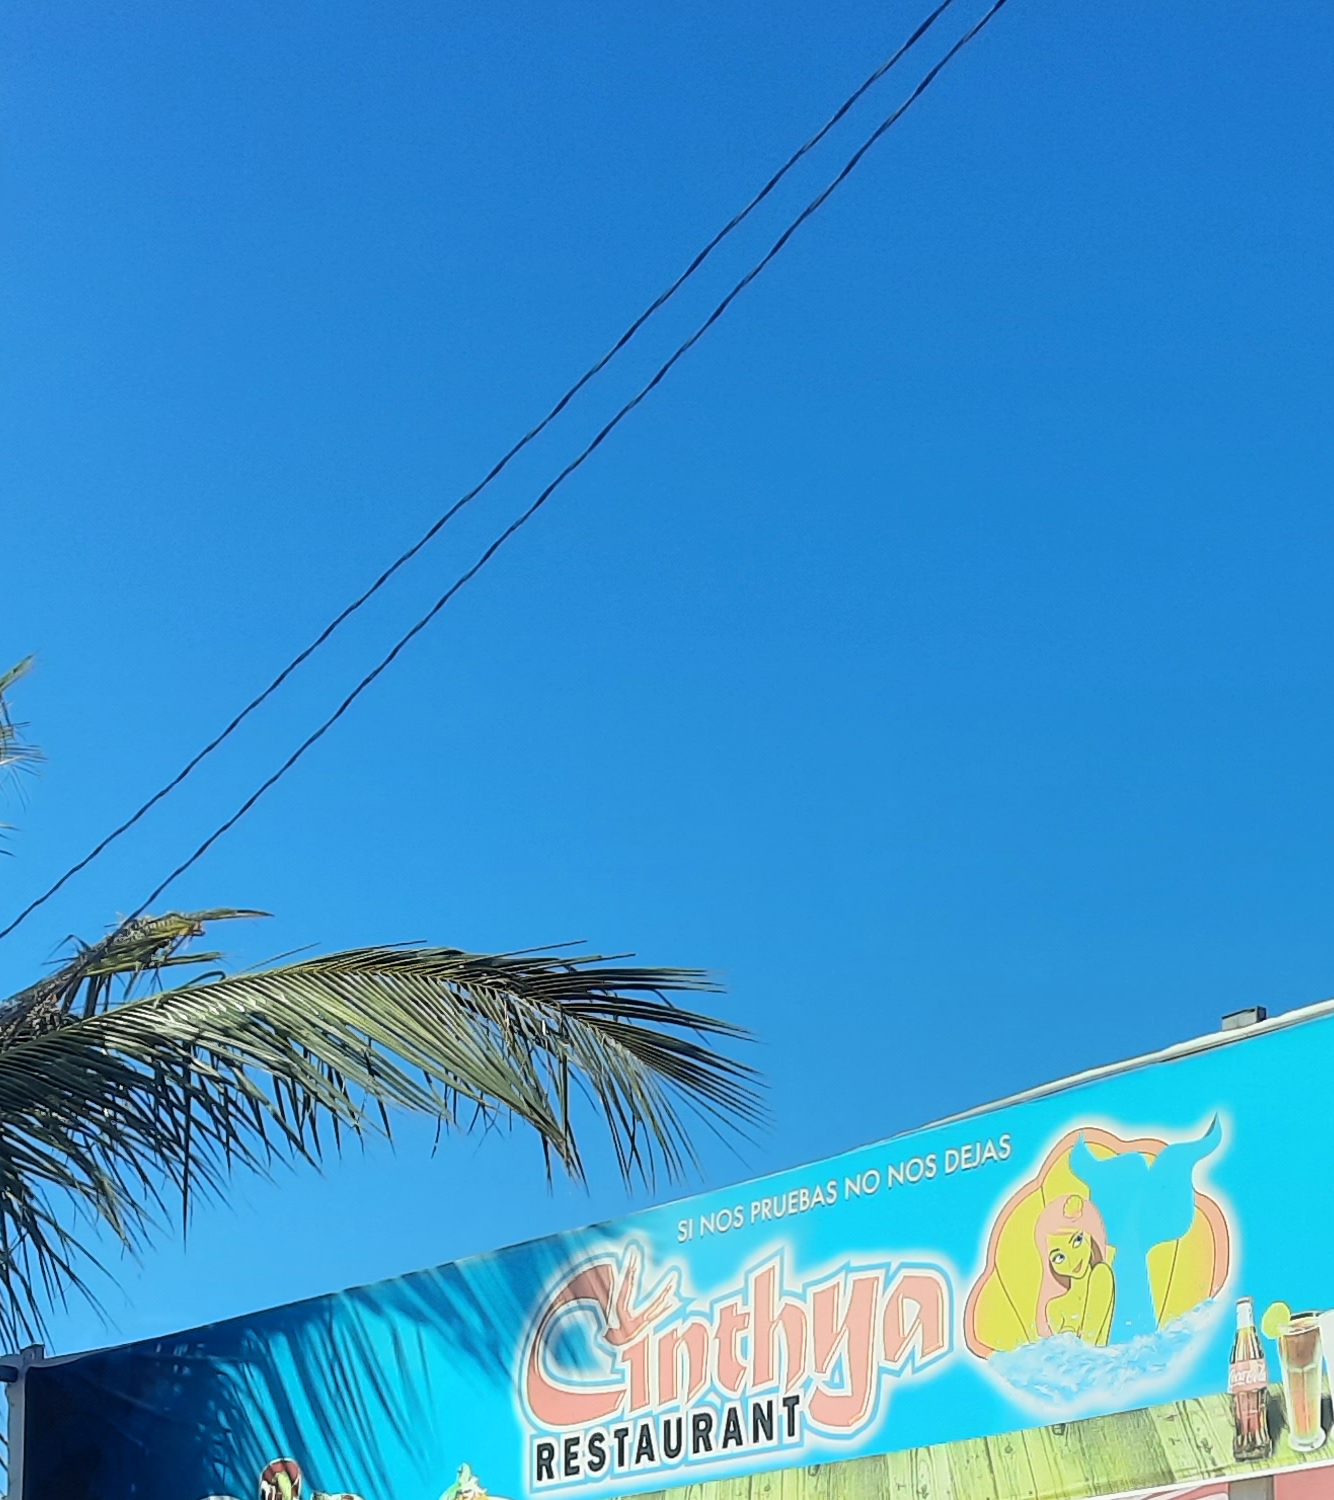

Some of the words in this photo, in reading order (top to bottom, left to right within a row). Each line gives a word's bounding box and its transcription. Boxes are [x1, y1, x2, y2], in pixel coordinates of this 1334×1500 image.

[677, 1219, 694, 1243] SI
[700, 1209, 744, 1236] NOS
[750, 1180, 838, 1224] PRUEBAS
[844, 1169, 880, 1201] NO
[887, 1154, 938, 1188] NOS
[944, 1133, 1012, 1176] DEJAS
[526, 1252, 946, 1428] Cinthya
[535, 1394, 800, 1482] RESTAURANT
